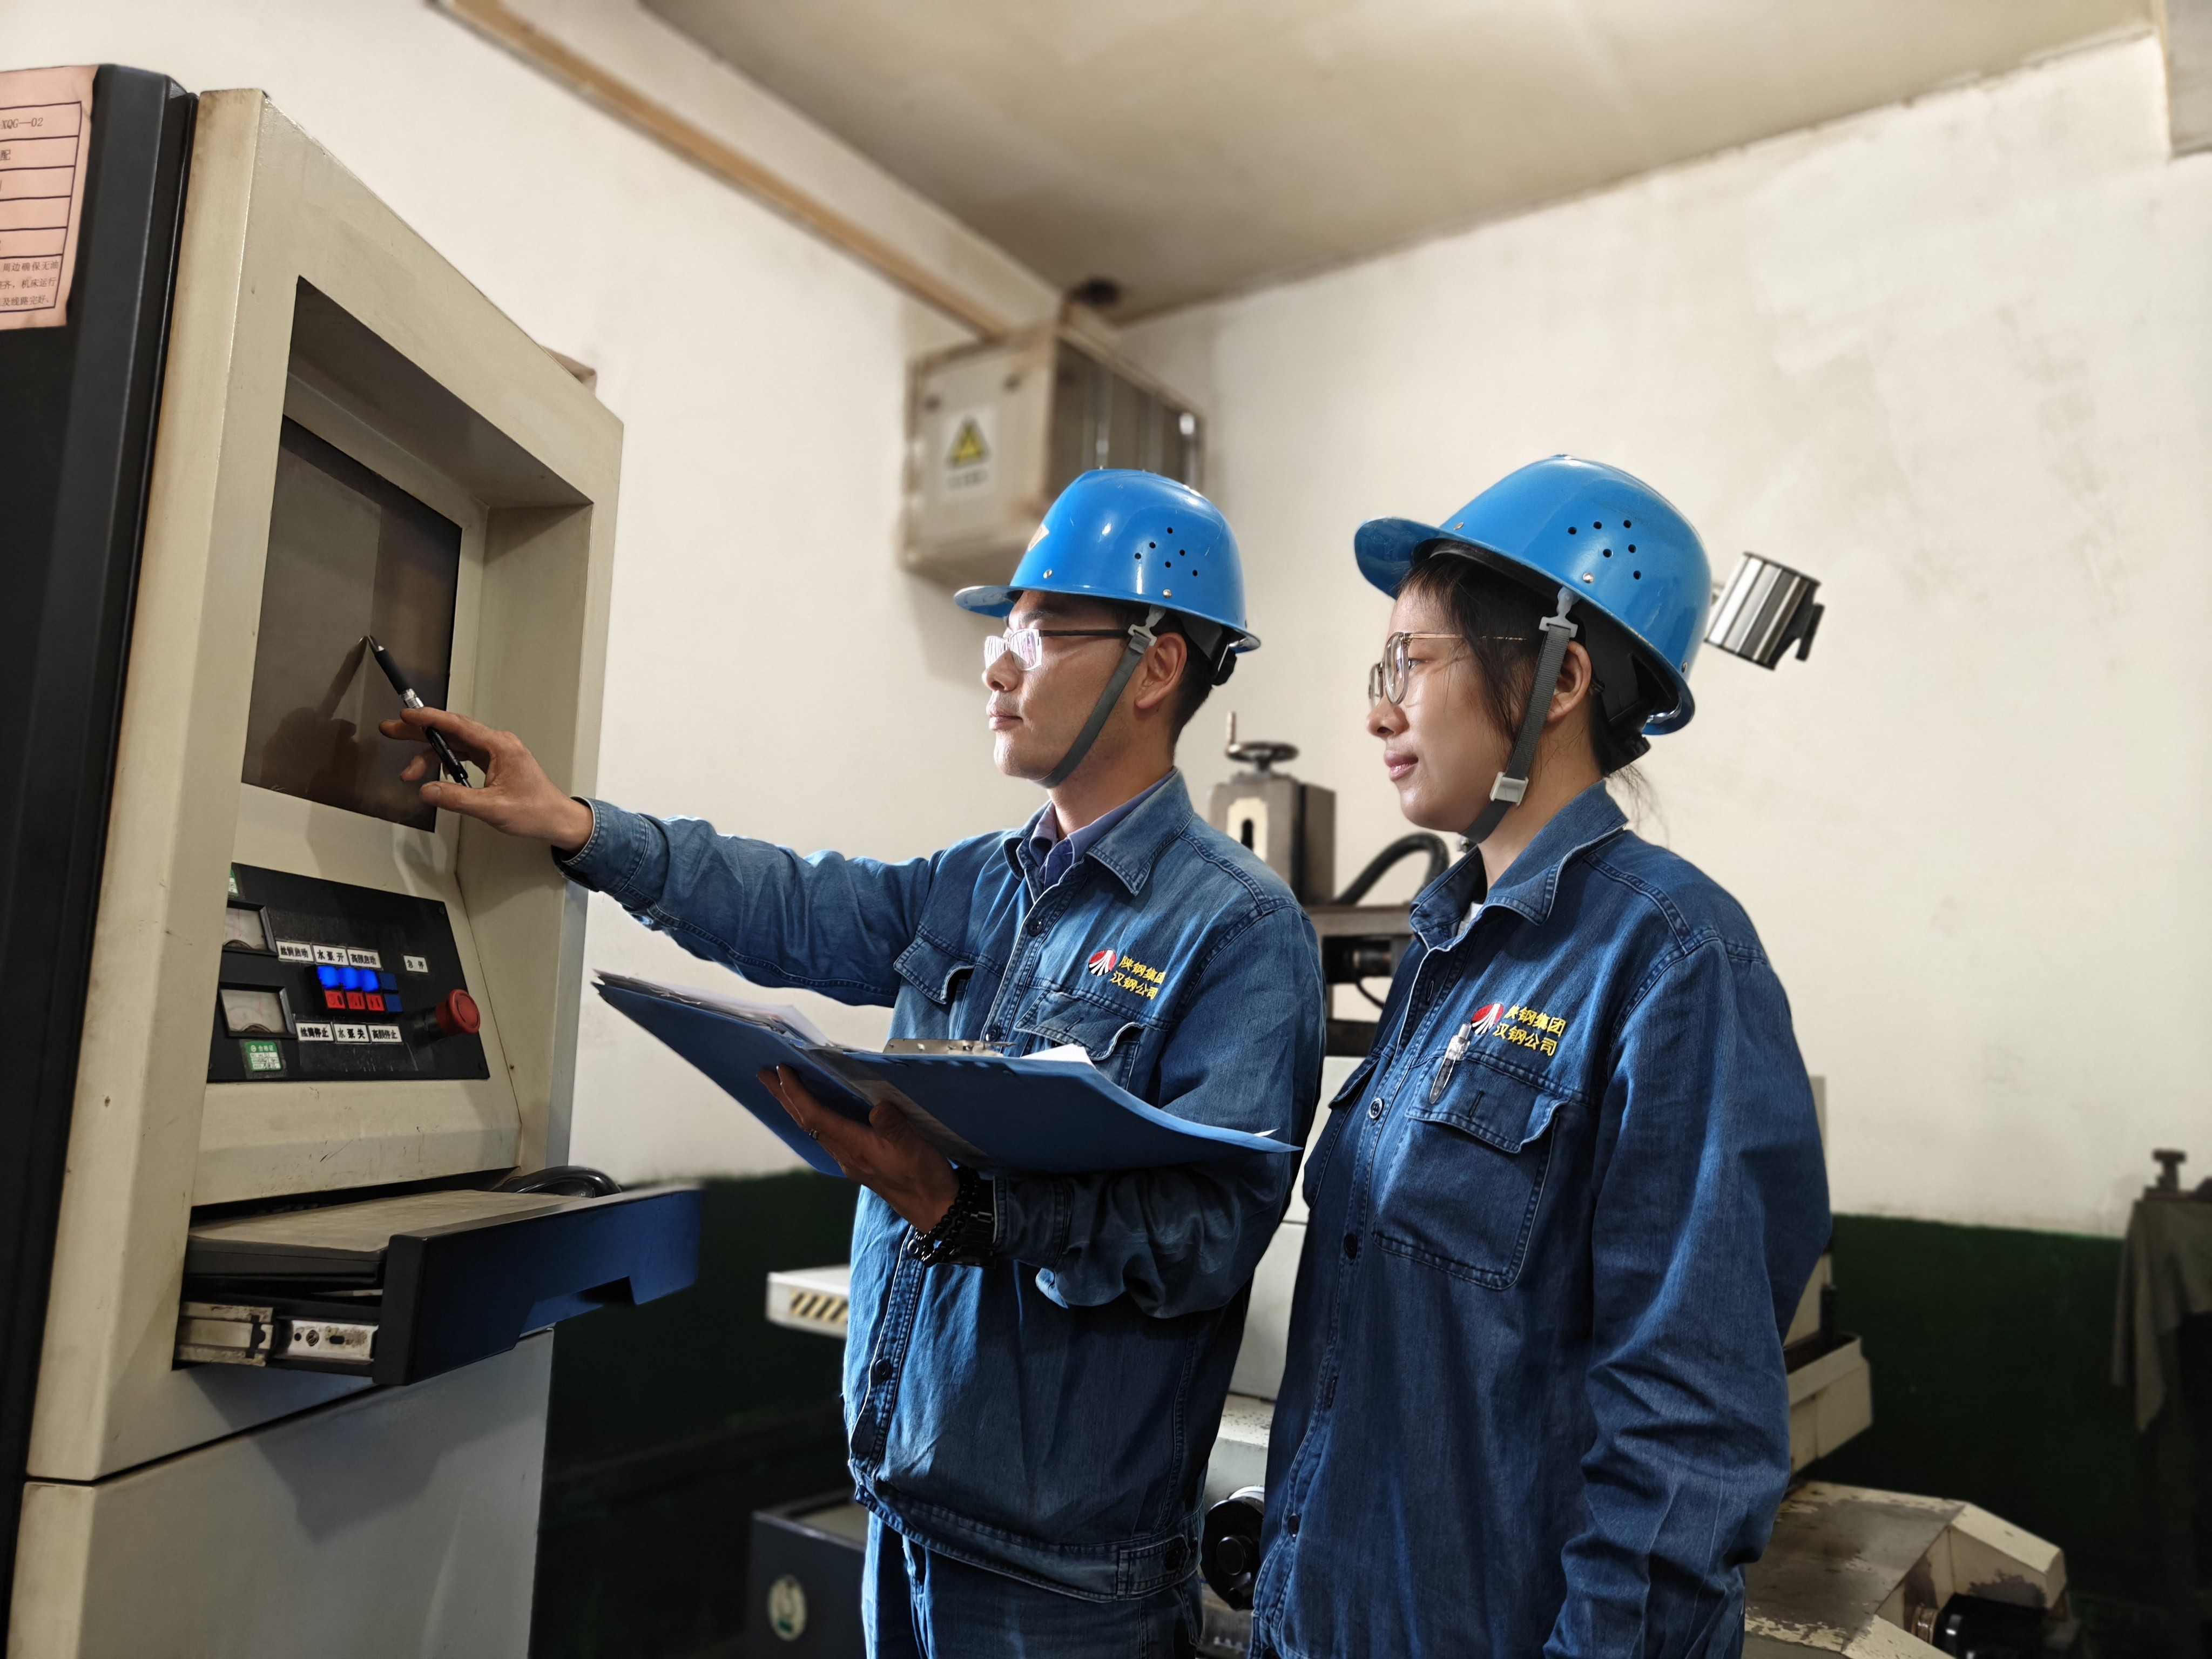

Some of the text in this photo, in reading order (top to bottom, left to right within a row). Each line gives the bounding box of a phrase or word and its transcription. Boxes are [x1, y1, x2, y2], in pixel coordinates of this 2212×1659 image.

[1118, 955, 1166, 984] 陕钢集团
[1110, 970, 1158, 1000] 汉钢公司
[1493, 1022, 1558, 1056] 汉钢公司
